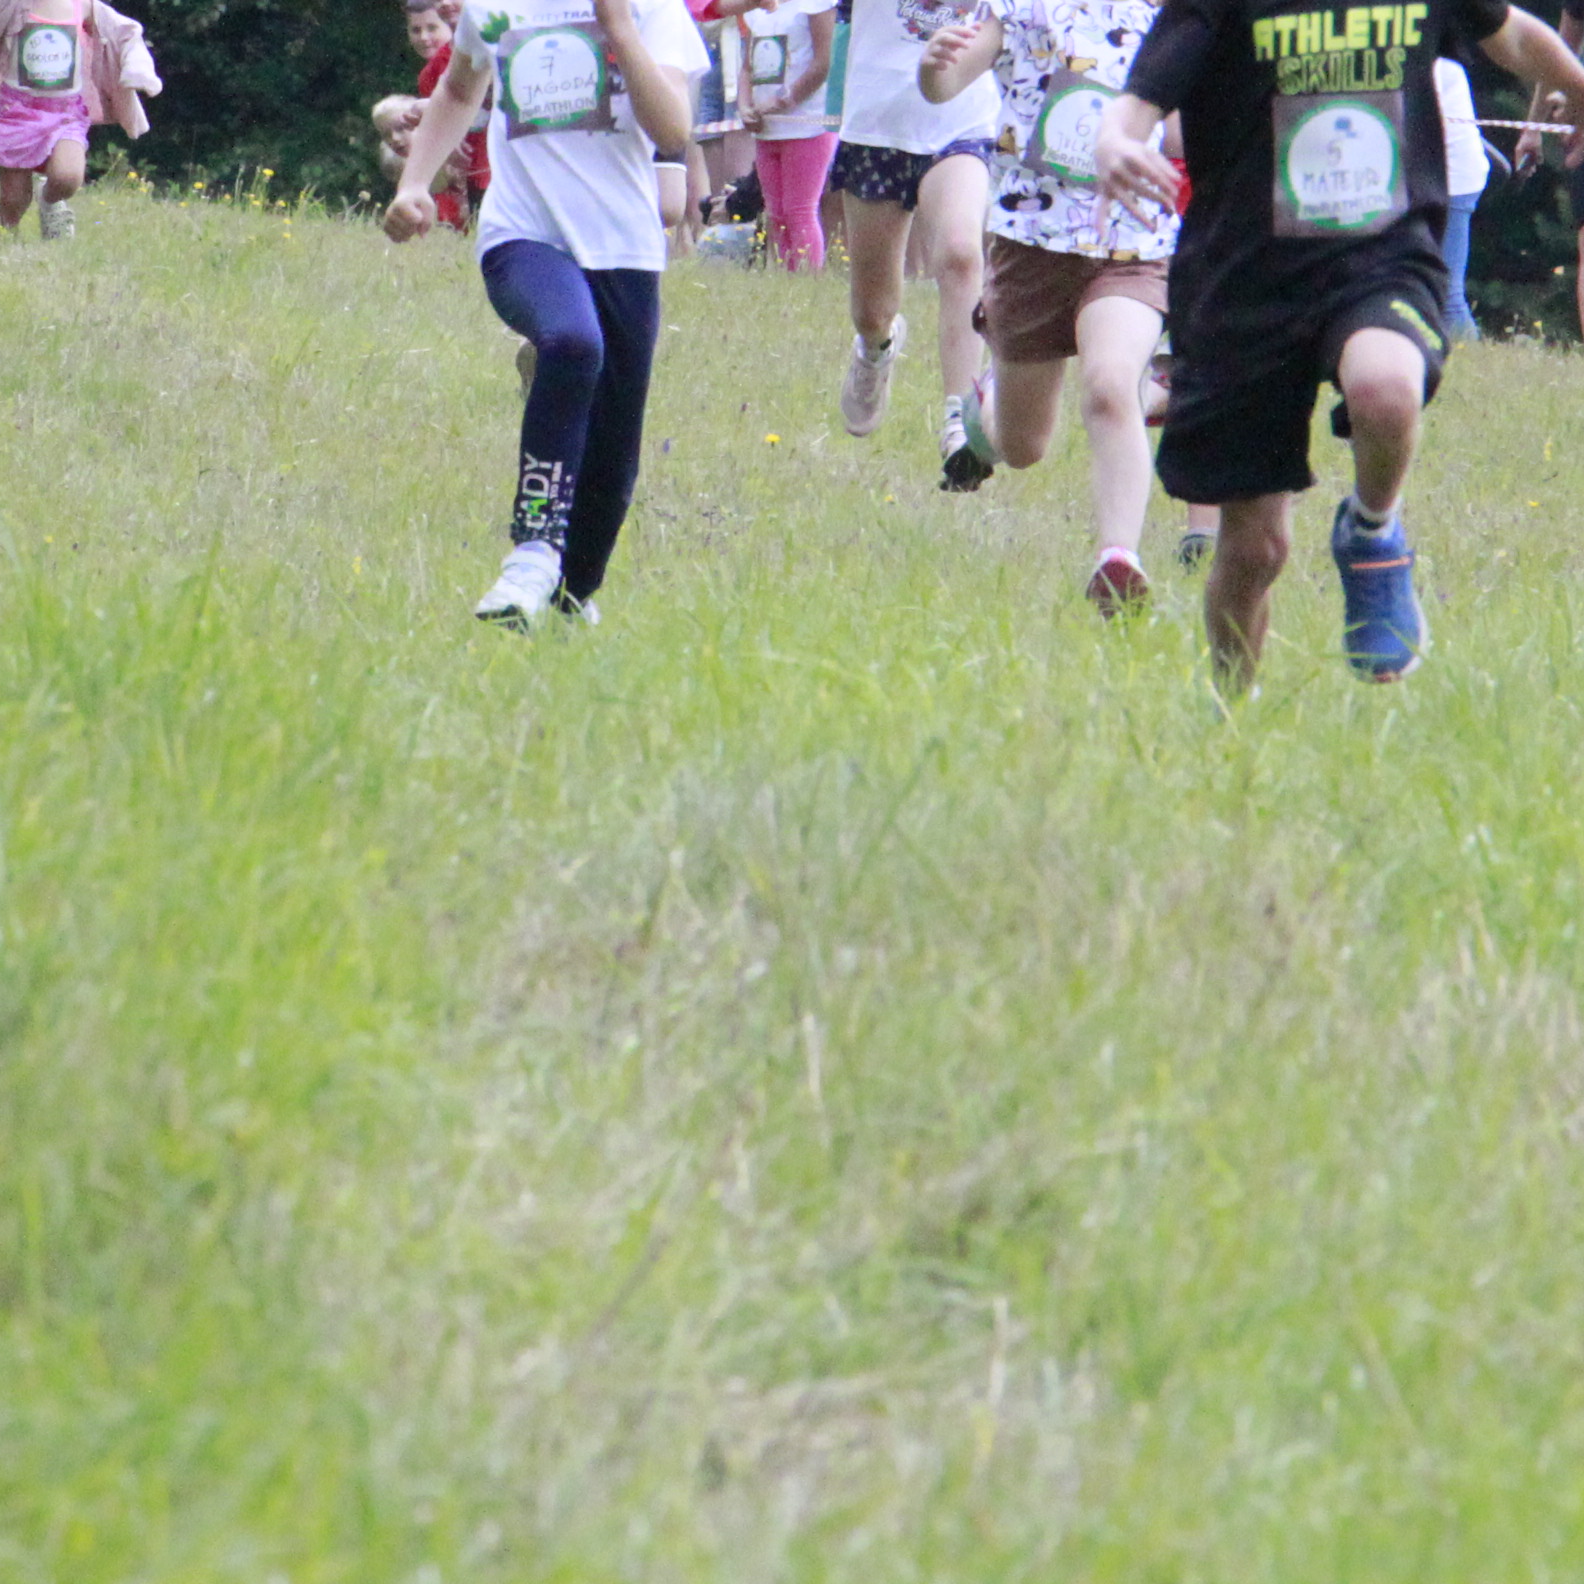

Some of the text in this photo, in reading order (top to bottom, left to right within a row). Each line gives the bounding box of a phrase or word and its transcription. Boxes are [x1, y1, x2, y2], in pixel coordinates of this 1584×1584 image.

[1253, 3, 1428, 62] ATHLETIC
[537, 54, 555, 78] 7
[1277, 46, 1407, 95] SKILLS
[522, 71, 597, 106] JAGODA
[1076, 113, 1092, 137] 6
